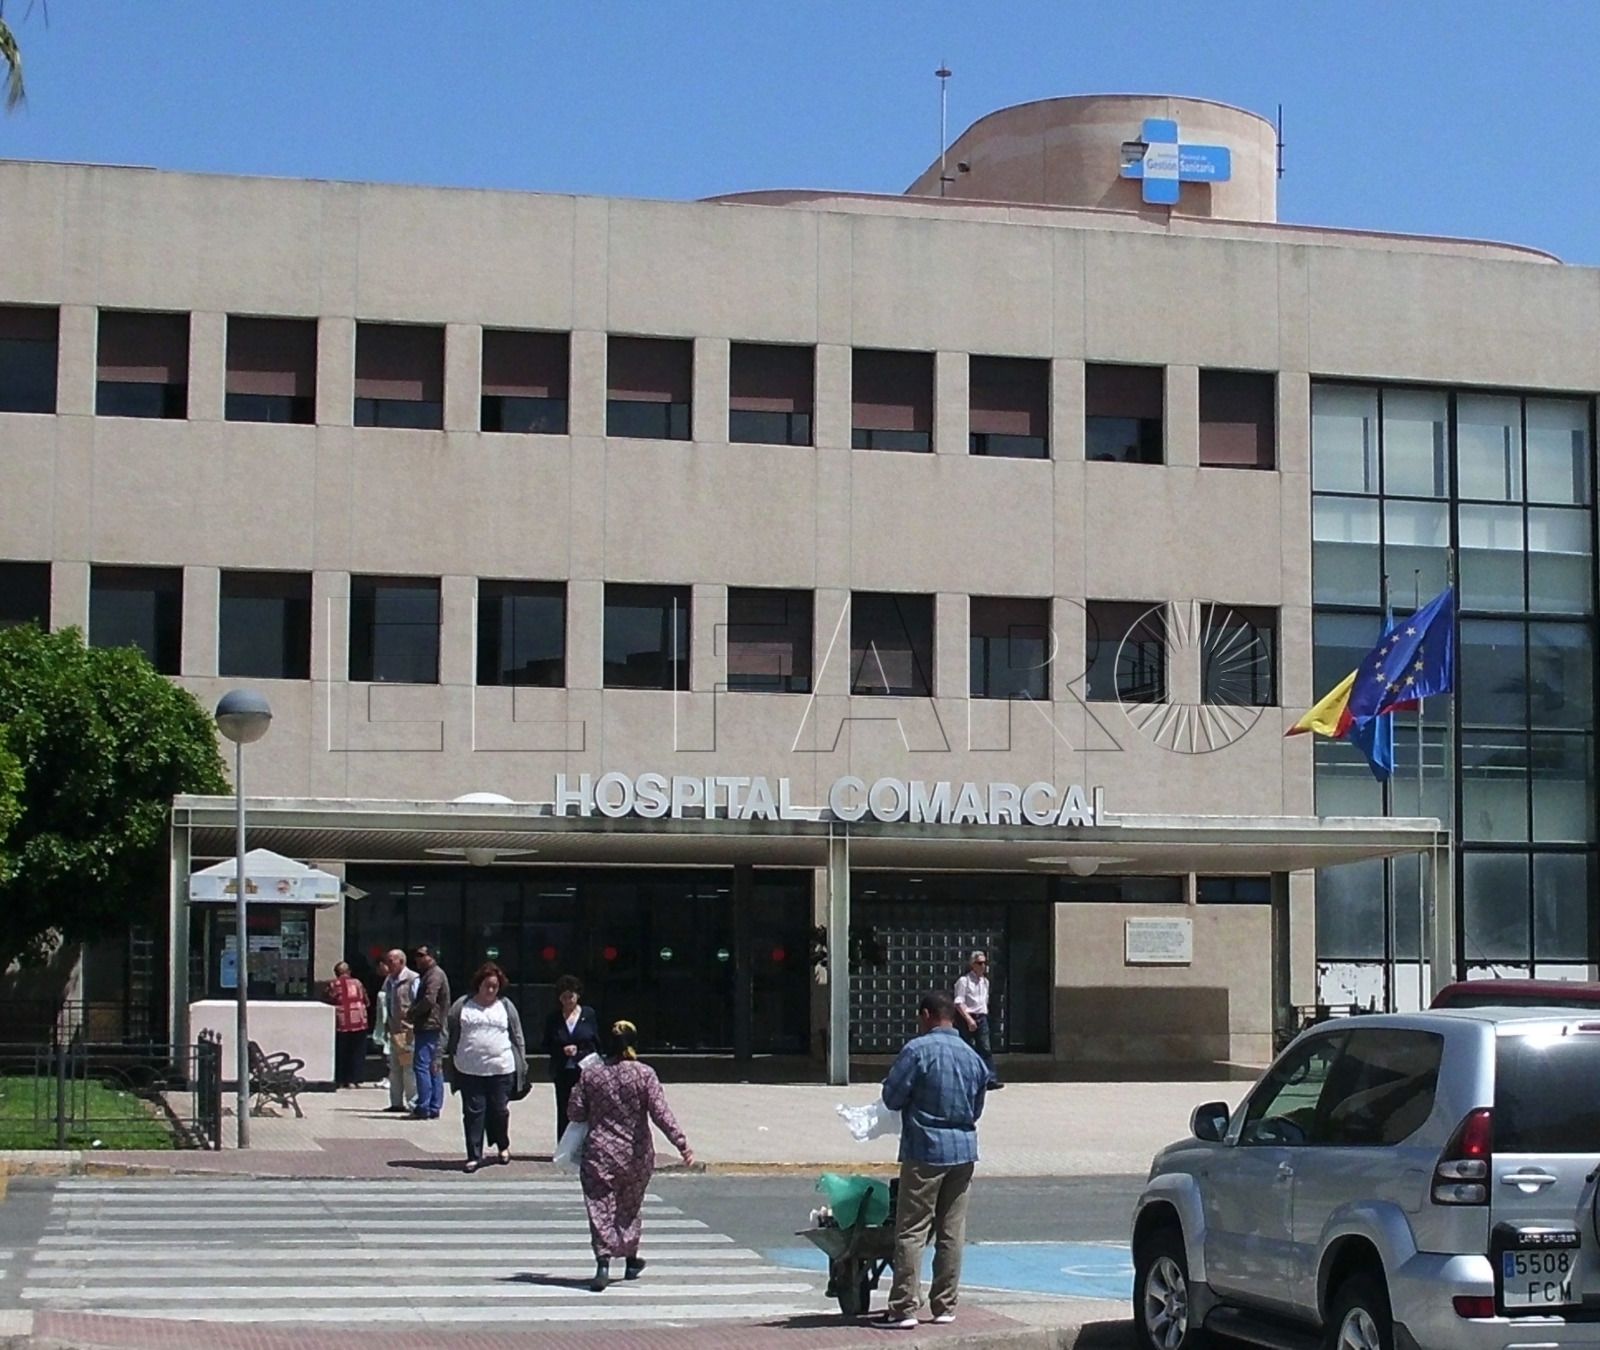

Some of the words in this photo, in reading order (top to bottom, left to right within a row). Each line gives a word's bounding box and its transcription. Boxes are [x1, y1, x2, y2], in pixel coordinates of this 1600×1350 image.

[554, 771, 797, 821] HOSPITAL
[828, 775, 1117, 827] COMARCAL
[1516, 1252, 1569, 1275] 5508
[1528, 1281, 1572, 1303] FCM
